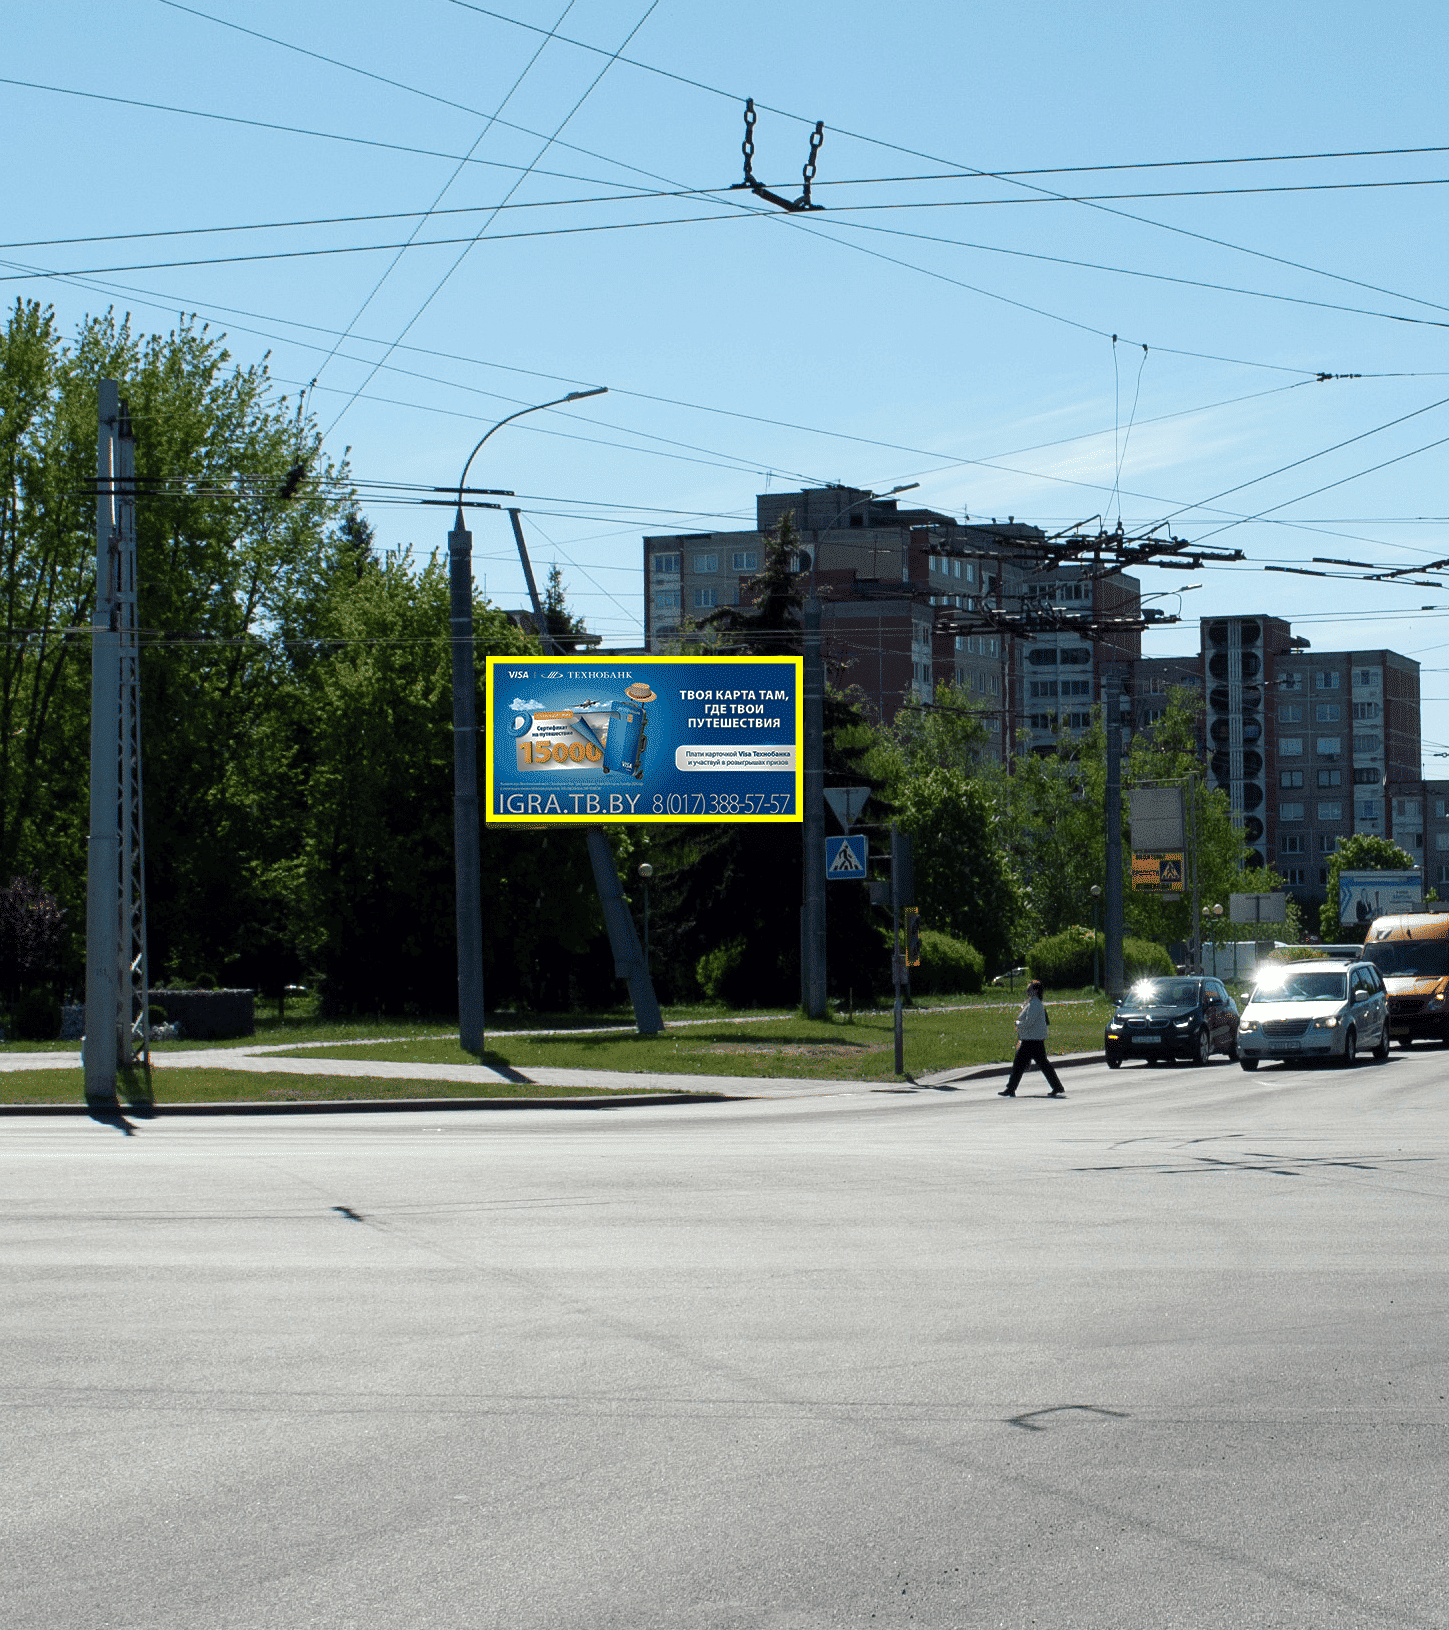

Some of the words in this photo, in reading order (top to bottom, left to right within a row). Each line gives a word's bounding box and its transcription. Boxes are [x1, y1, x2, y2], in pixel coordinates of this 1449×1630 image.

[508, 671, 529, 679] VISA
[567, 671, 633, 679] ТЕХНОБАНК
[680, 690, 713, 700] ТВОЯ
[716, 690, 756, 700] КАРТА
[759, 690, 789, 702] ТАМ,
[704, 704, 727, 716] ГДЕ
[730, 704, 764, 714] ТВОИ
[688, 718, 781, 728] ПУТЕШЕСТВИЯ
[519, 740, 602, 764] 15000
[685, 750, 704, 758] Плати
[704, 750, 738, 758] карточкой
[693, 759, 721, 767] участвуй
[500, 793, 641, 814] IGRA.TB.BY
[652, 793, 664, 814] 8
[666, 793, 706, 815] (017)
[709, 793, 791, 814] 388-57-57
